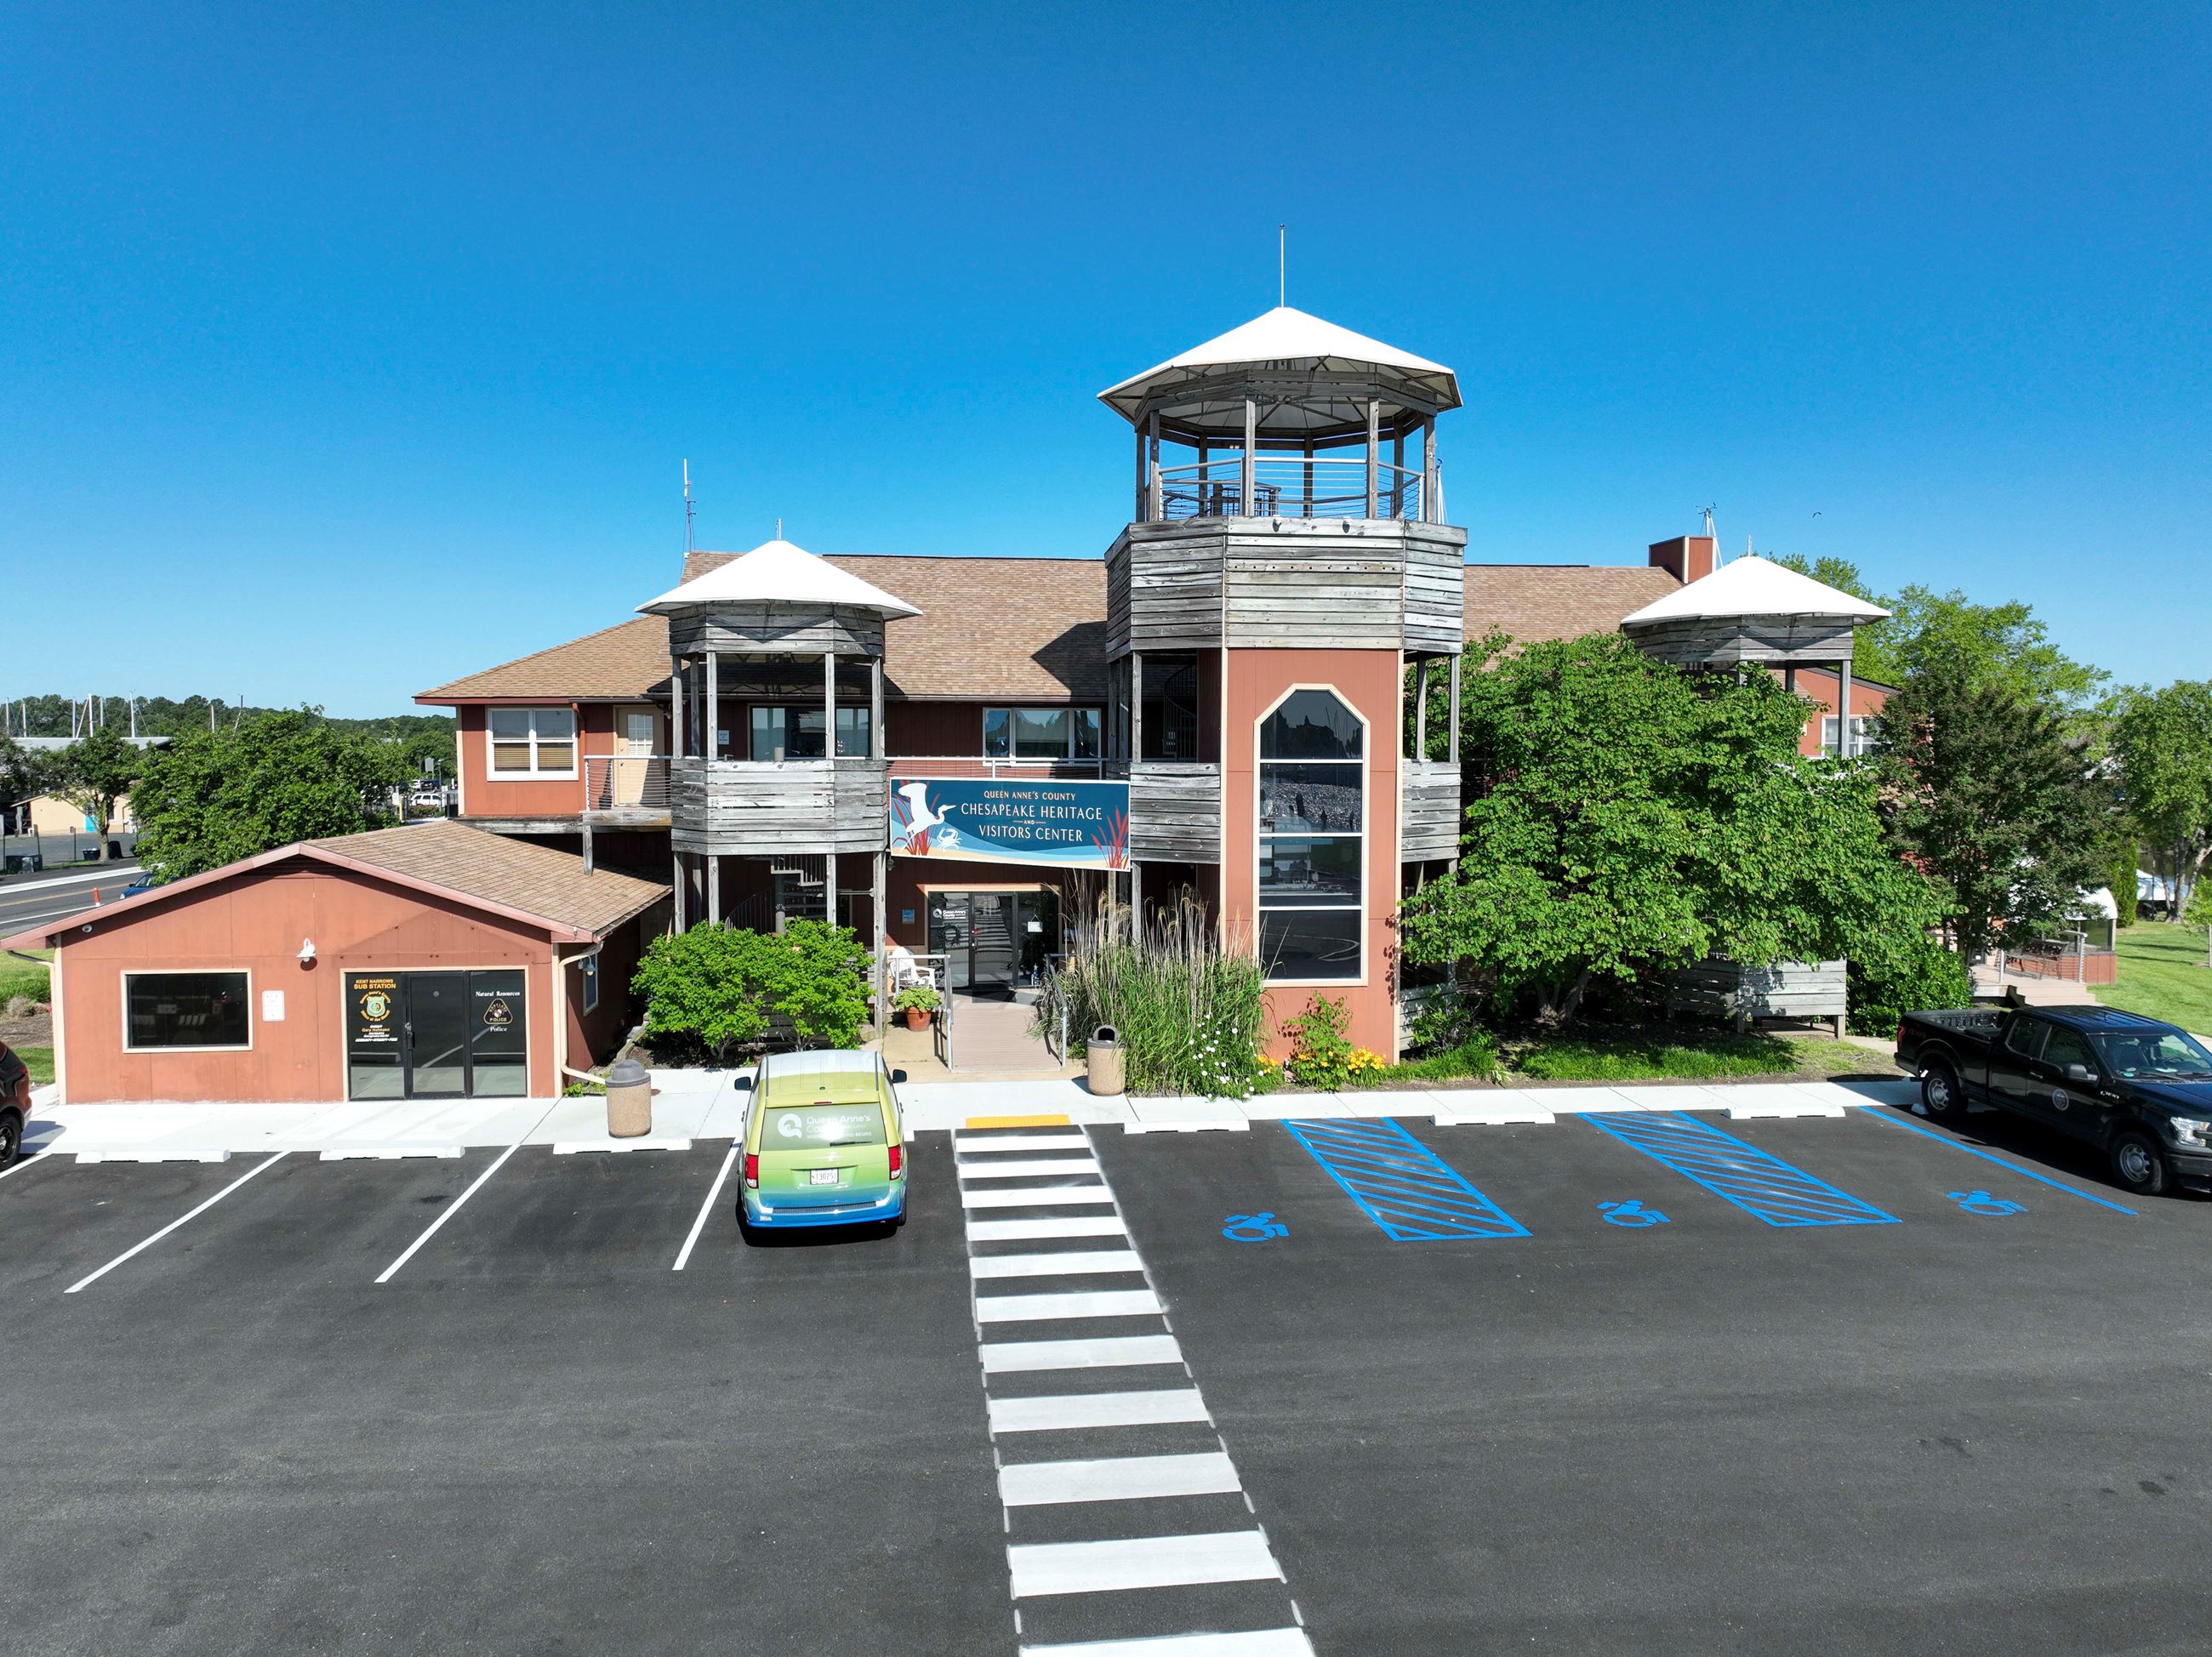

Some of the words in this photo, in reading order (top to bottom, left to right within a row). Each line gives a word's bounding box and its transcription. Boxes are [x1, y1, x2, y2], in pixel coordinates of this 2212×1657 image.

[983, 790, 1009, 799] QUEEN
[1012, 791, 1039, 800] ANNE'S
[1041, 792, 1076, 801] COUNTY
[961, 802, 1035, 817] CHESAPEAKE
[1040, 806, 1103, 820] HERITAGE
[978, 824, 1031, 839] VISITORS
[1035, 828, 1083, 842] CENTER
[840, 1114, 872, 1123] Anne's
